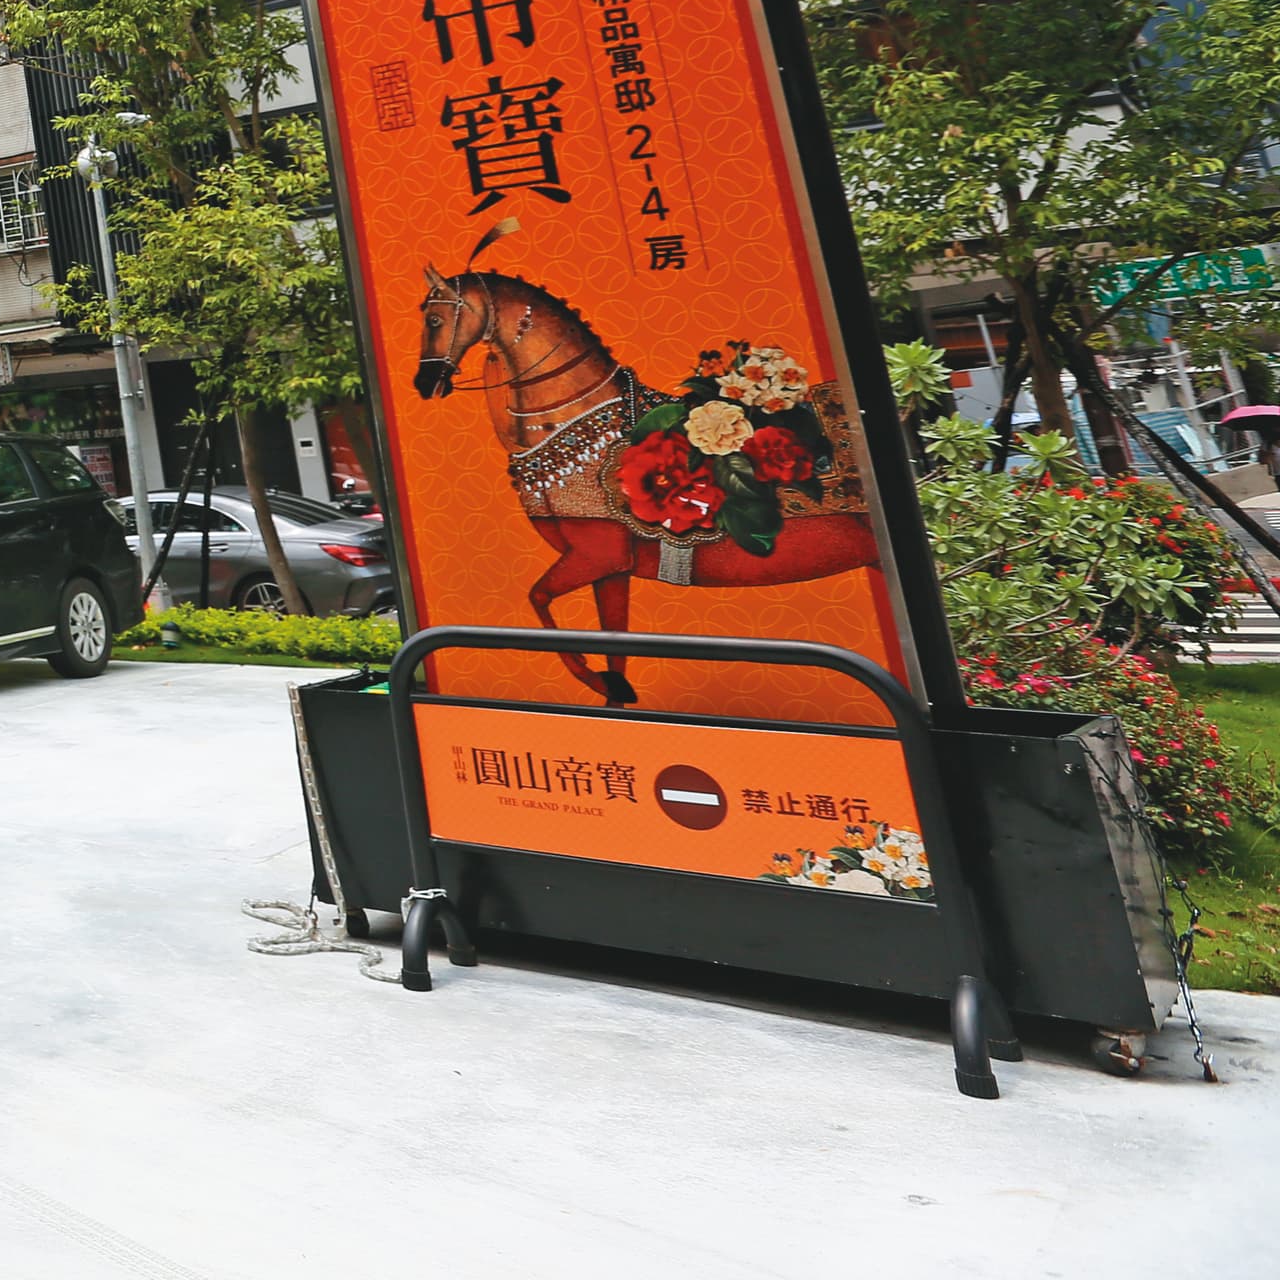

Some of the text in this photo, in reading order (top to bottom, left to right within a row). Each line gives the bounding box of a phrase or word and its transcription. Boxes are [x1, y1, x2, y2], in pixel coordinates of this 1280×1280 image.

[472, 747, 638, 803] 圓山帝寶
[498, 796, 605, 817] THE GRAND PALACE
[742, 789, 870, 823] 禁止通行
